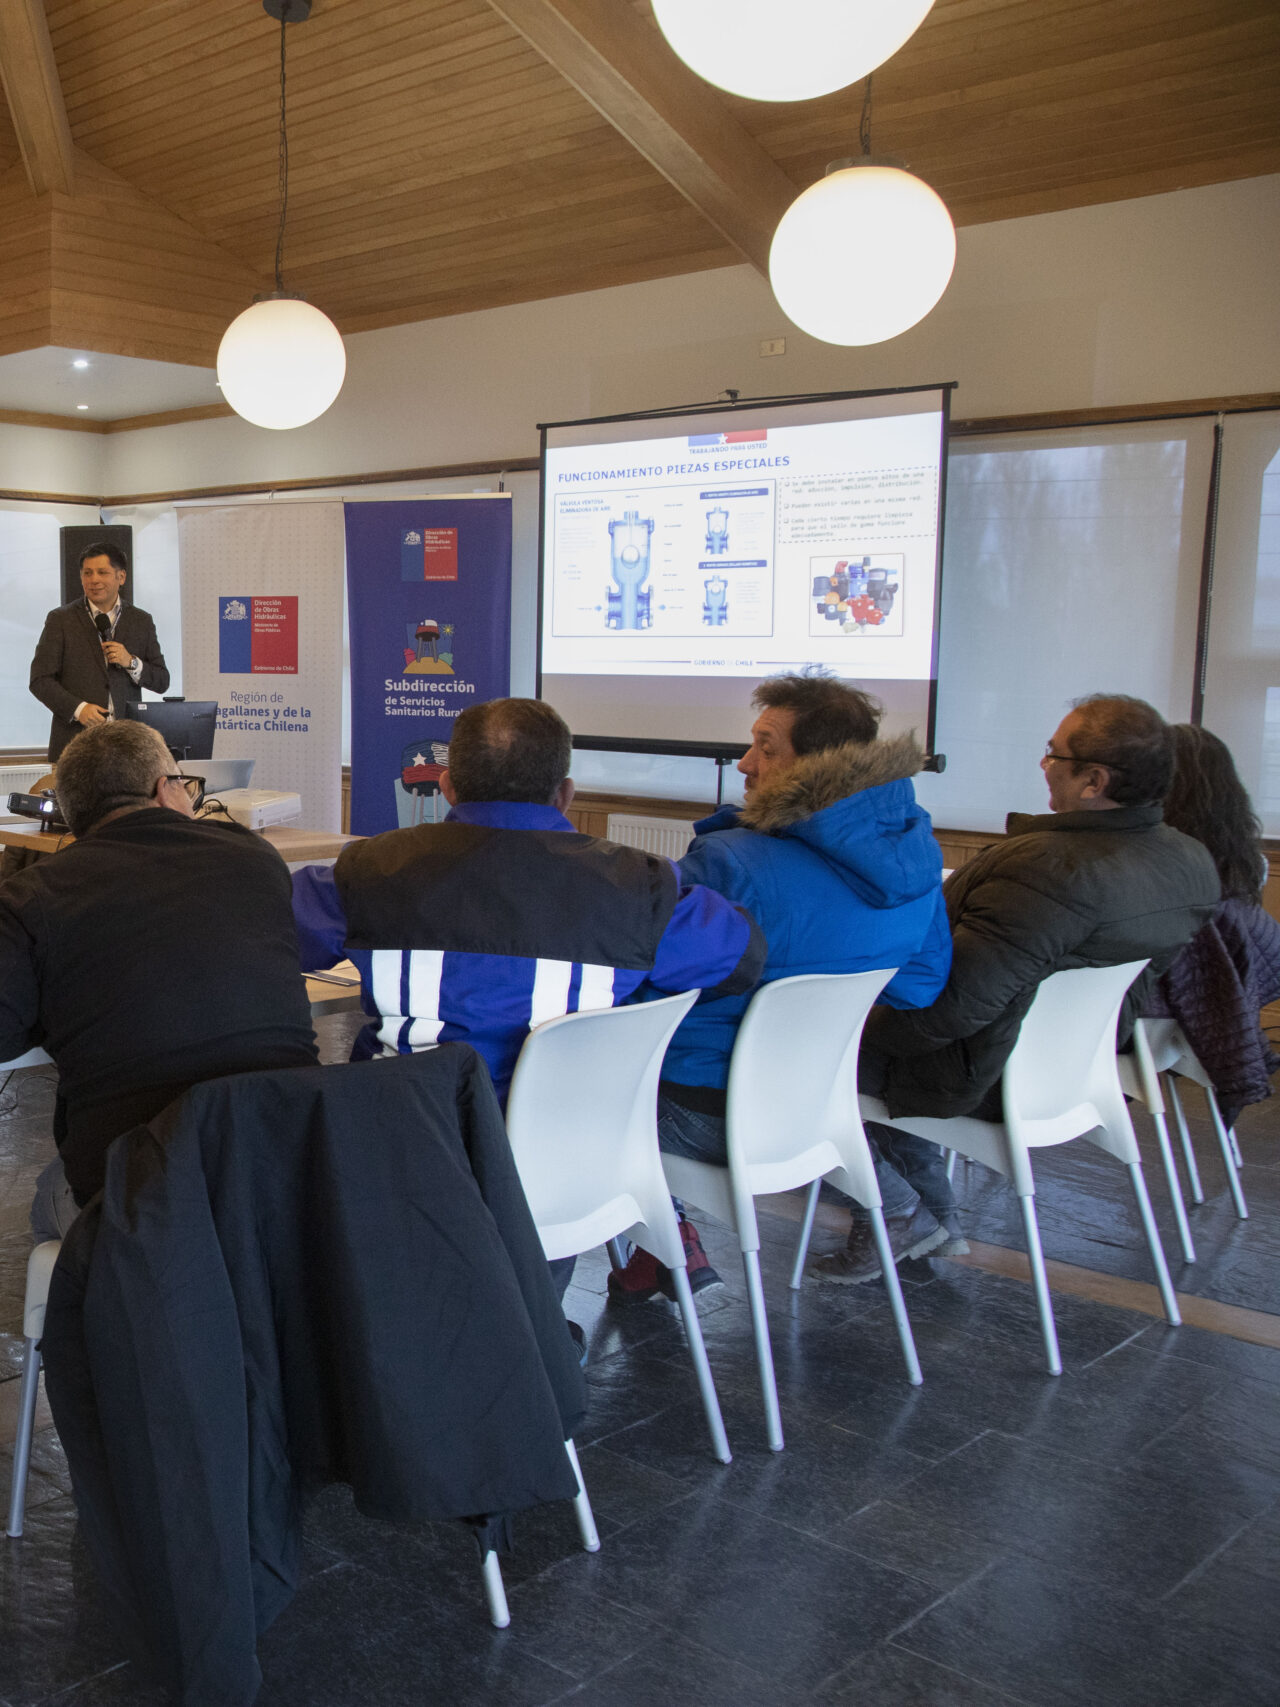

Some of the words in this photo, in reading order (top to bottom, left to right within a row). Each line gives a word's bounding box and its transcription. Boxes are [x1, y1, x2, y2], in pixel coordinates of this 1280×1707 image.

[689, 446, 729, 454] TRABAJANDO
[747, 442, 768, 450] USTED
[558, 466, 663, 483] FUNCIONAMIENTO
[667, 462, 710, 475] PIEZAS
[714, 456, 790, 472] ESPECIALES
[384, 679, 475, 694] Subdirección
[230, 691, 267, 705] Región
[270, 692, 284, 703] de
[384, 696, 398, 705] de
[400, 696, 446, 706] Servicios
[216, 705, 270, 718] agallanes
[272, 707, 280, 719] y
[283, 706, 297, 718] de
[300, 707, 311, 718] la
[384, 706, 436, 717] Sanitarios
[215, 719, 261, 731] ntártica
[263, 721, 309, 733] Chilena
